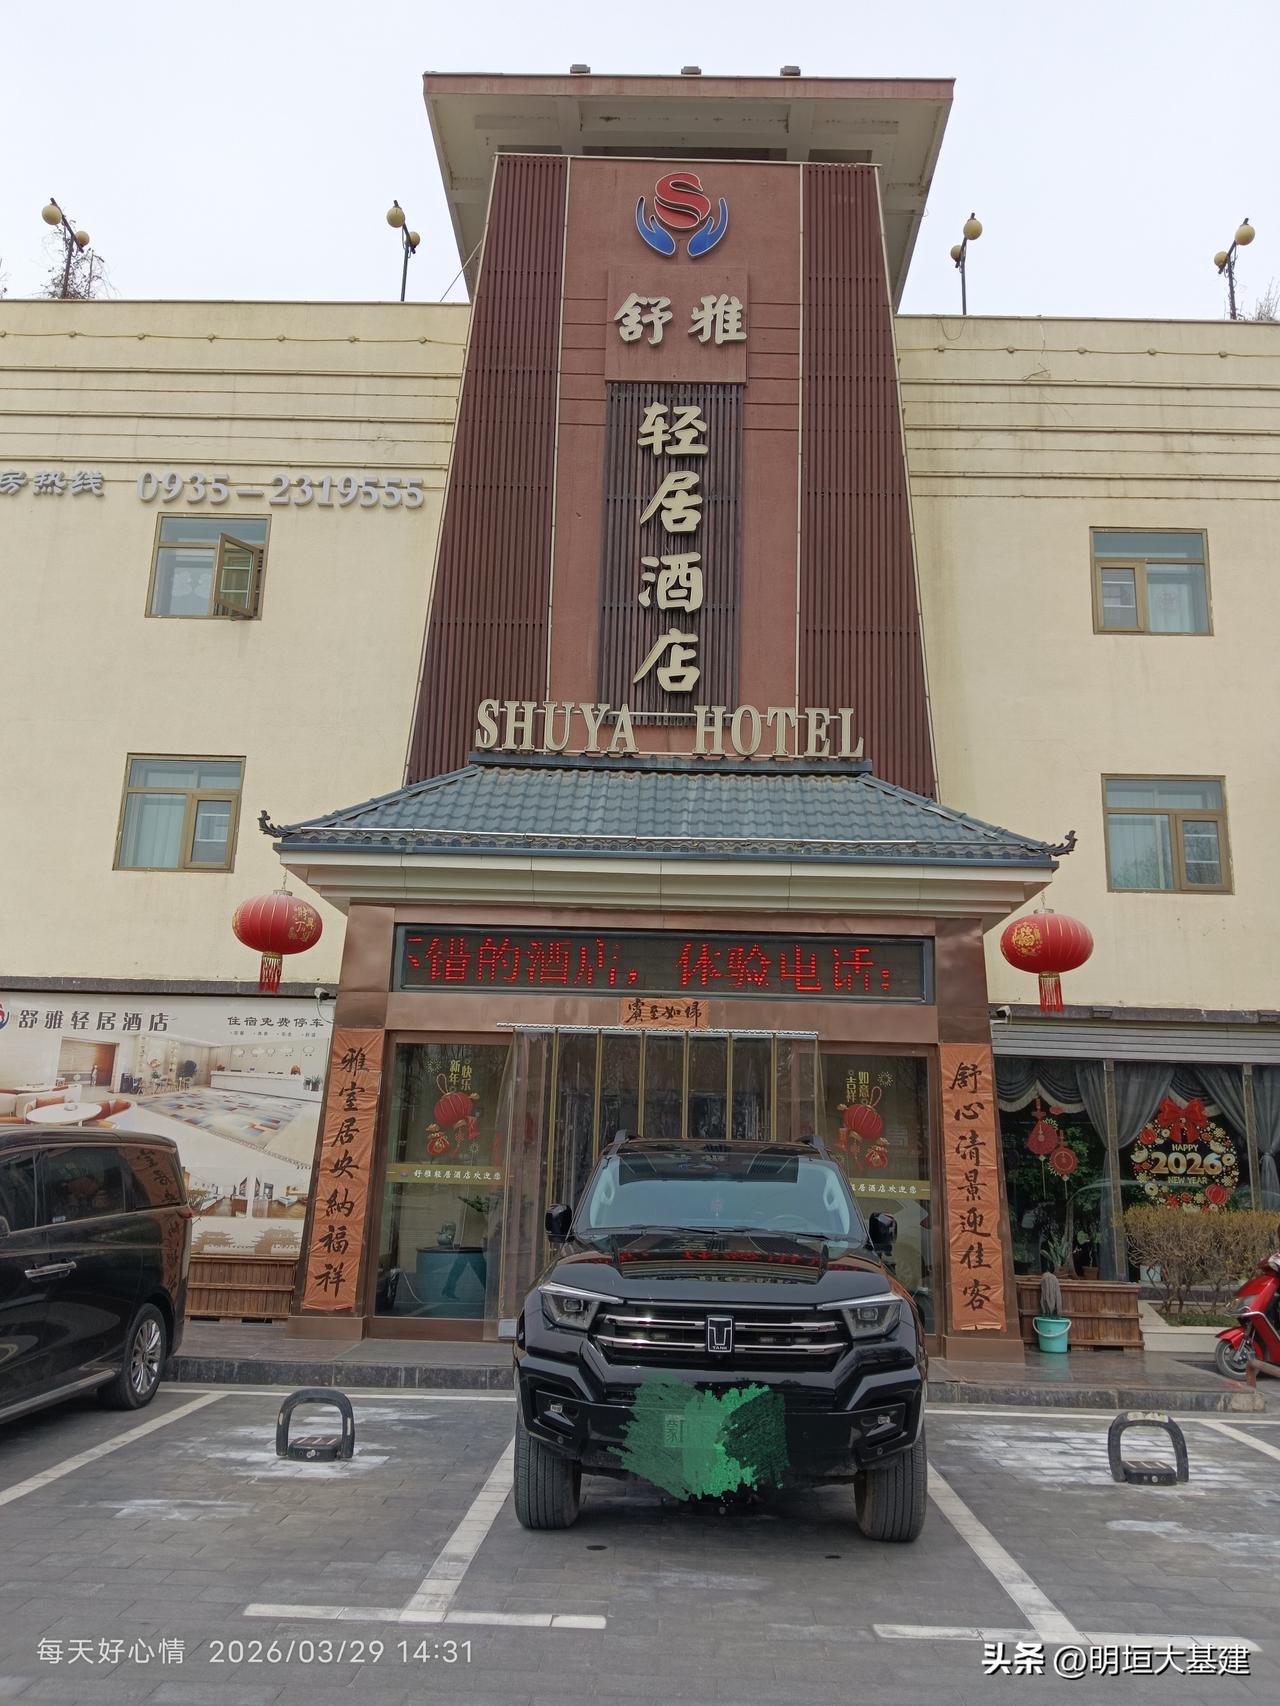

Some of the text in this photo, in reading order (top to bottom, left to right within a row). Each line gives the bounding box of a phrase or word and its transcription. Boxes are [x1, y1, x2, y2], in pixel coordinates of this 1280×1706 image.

[613, 292, 748, 347] 舒雅
[633, 401, 708, 693] 轻居酒店
[475, 698, 864, 759] SHUYA HOTEL
[18, 1009, 169, 1032] 舒雅轻居酒店
[226, 1015, 325, 1028] 住宿免费停车
[450, 1059, 461, 1086] 新年
[461, 1065, 473, 1091] 快乐
[858, 1071, 870, 1098] 如意
[1171, 1143, 1199, 1152] HAPPY
[1150, 1151, 1223, 1176] 2026
[1168, 1176, 1208, 1185] NEW YEAR
